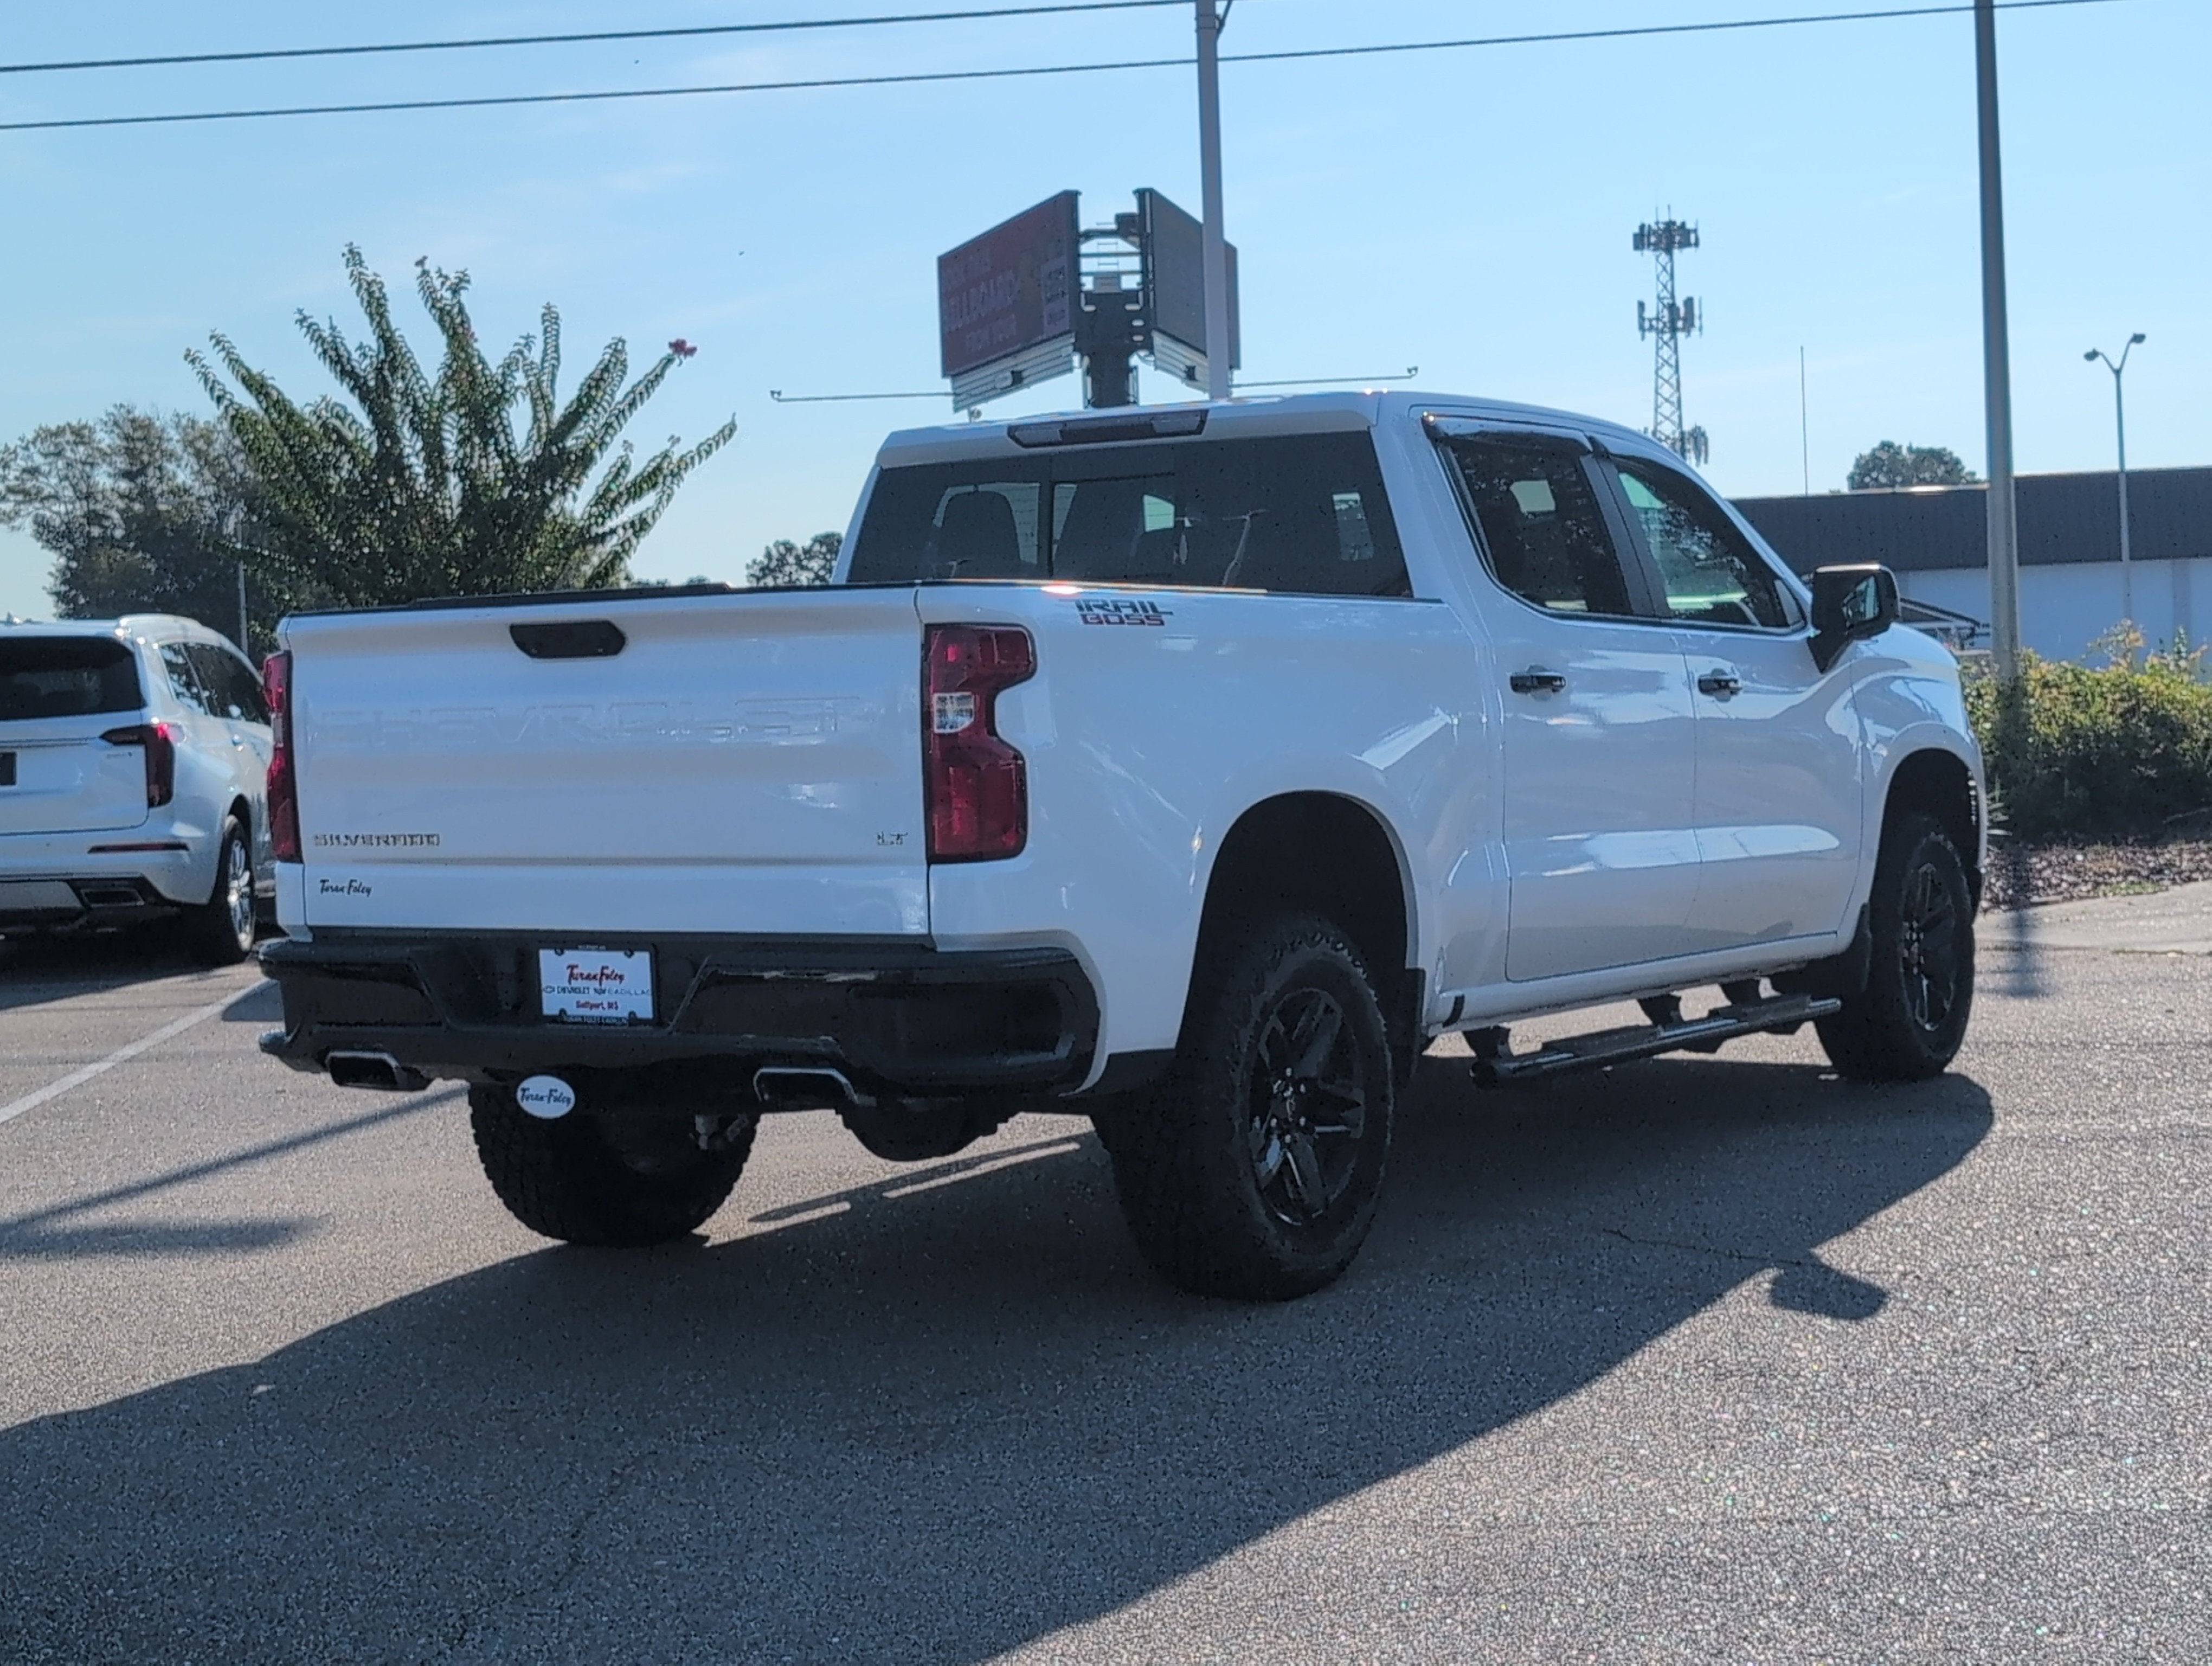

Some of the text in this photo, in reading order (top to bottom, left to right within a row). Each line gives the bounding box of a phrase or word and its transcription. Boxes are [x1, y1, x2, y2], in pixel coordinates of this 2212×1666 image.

[1066, 599, 1174, 616] TRAIL
[1081, 614, 1165, 626] BOSS
[314, 833, 440, 847] SILVERADO
